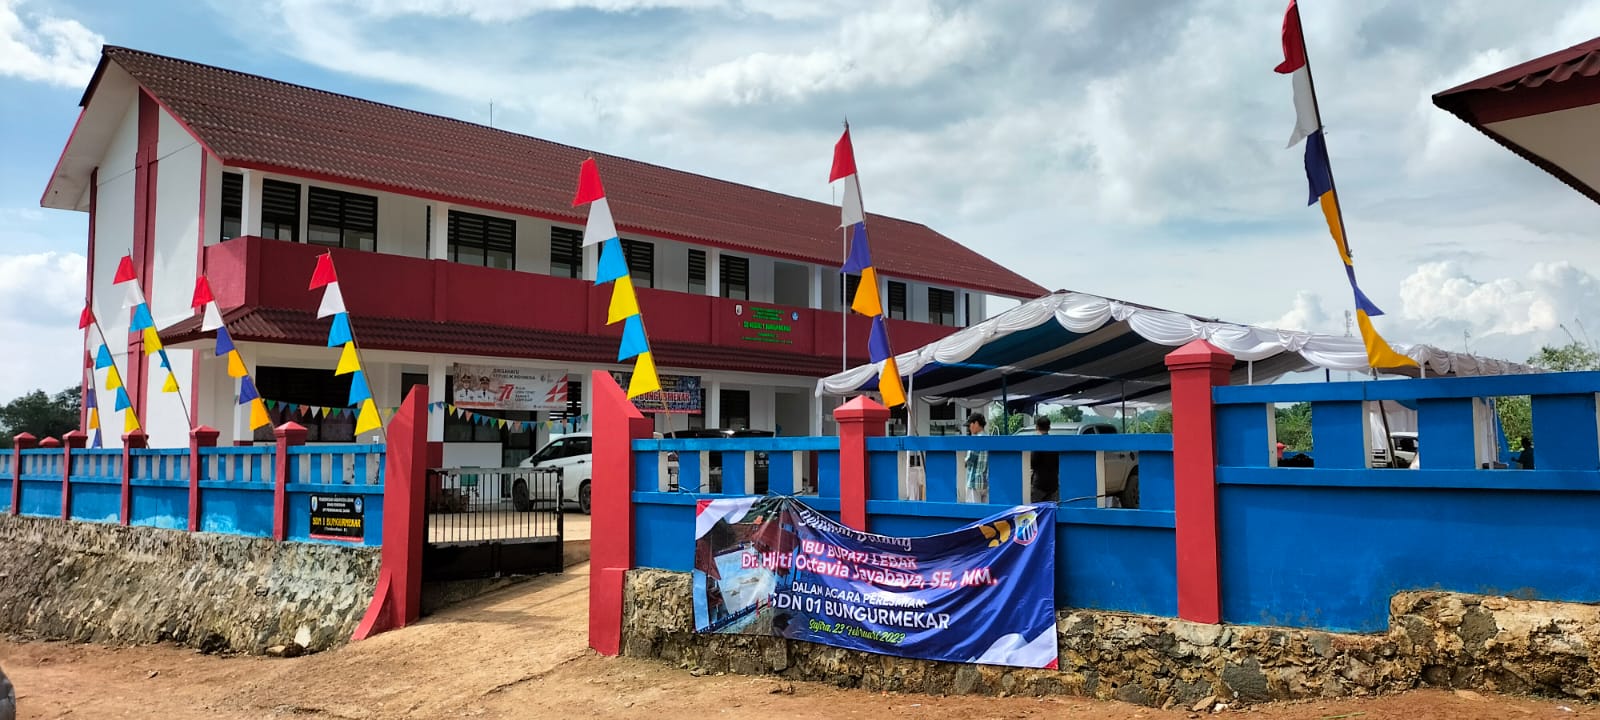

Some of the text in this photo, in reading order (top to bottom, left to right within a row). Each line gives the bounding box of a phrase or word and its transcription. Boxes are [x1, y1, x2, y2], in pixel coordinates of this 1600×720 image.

[498, 384, 514, 401] 77
[802, 540, 918, 569] IBU BUPATI LEBAK
[742, 551, 759, 568] Dr.
[795, 554, 850, 577] Octavia
[960, 567, 999, 588] MM.
[825, 587, 861, 603] ACARA
[863, 593, 927, 609] PERESMIAN
[772, 593, 950, 630] SDN 01 BUNGURMEKAR
[832, 623, 845, 634] 23
[879, 631, 906, 644] 2023
